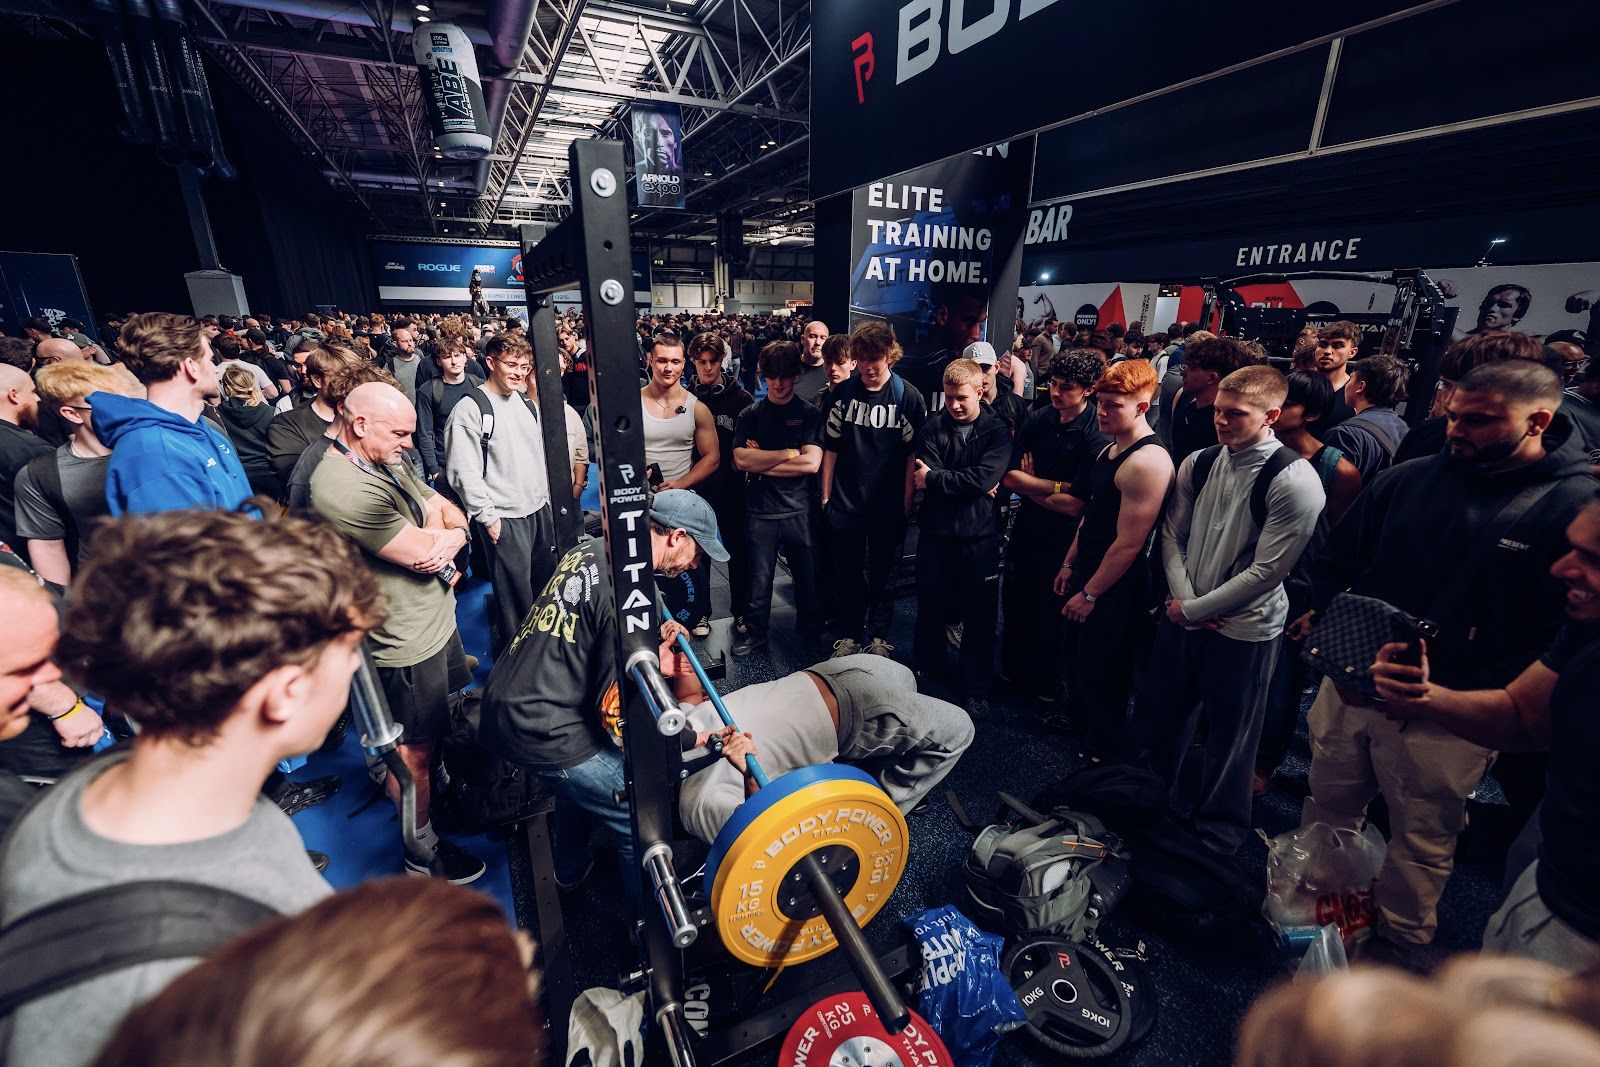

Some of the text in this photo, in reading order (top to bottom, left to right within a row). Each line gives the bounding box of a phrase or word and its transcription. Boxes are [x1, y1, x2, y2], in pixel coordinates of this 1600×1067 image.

[436, 58, 469, 117] ABE
[641, 174, 680, 184] ARNOLD
[641, 182, 681, 198] expo
[868, 182, 943, 213] ELITE
[867, 219, 992, 251] TRAINING
[1024, 205, 1073, 245] BAR
[1236, 238, 1361, 266] ENTRANCE
[418, 263, 461, 272] ROGUE
[865, 256, 901, 281] AT
[908, 258, 988, 284] HOME.
[610, 493, 647, 505] POWER
[613, 486, 642, 497] BODY
[618, 509, 653, 634] TITAN
[680, 571, 696, 603] OWER
[765, 807, 894, 859] BODY POWER
[812, 822, 851, 838] TITAN
[738, 879, 764, 900] 15
[736, 897, 760, 914] KG
[824, 1010, 841, 1030] KG
[834, 1001, 857, 1025] 25
[793, 1026, 820, 1067] WER
[902, 1037, 924, 1067] TITA
